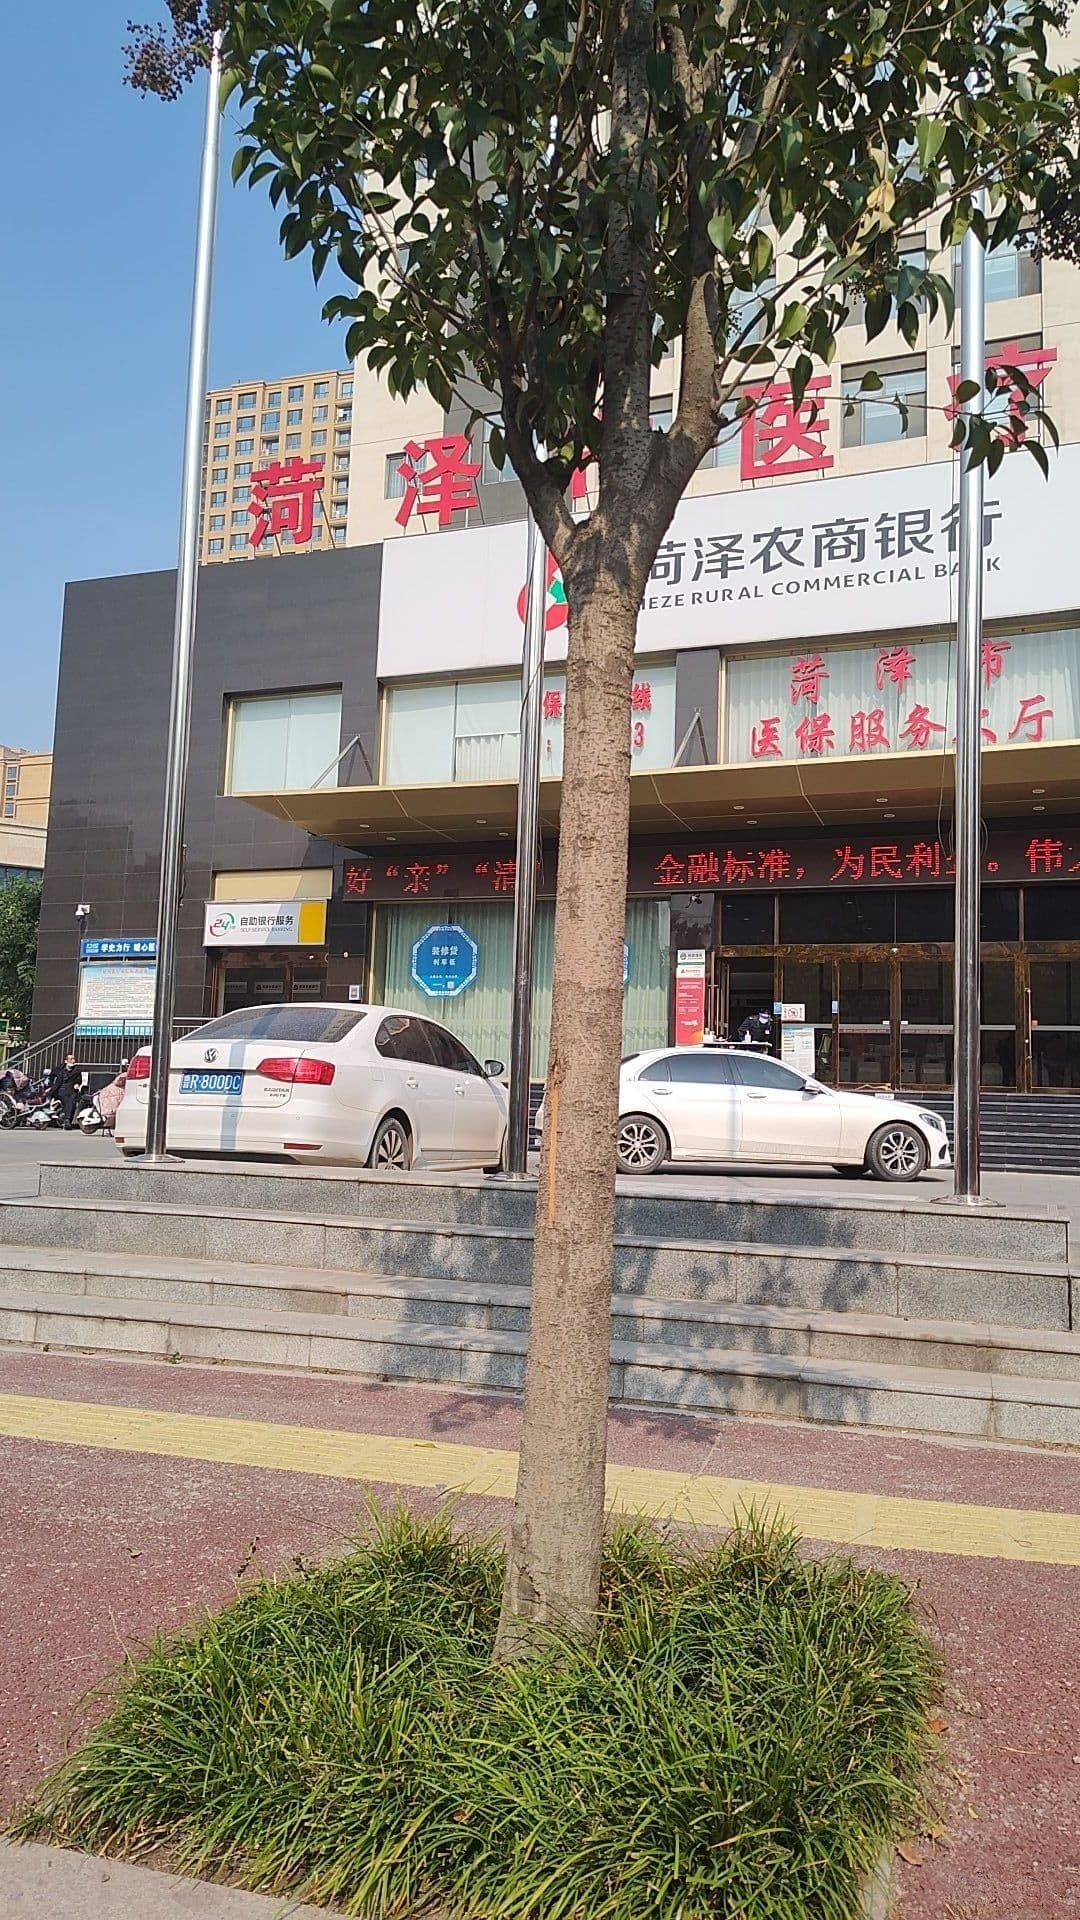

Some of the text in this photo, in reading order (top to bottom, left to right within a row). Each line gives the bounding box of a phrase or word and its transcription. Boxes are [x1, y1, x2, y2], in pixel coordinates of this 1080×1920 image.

[691, 585, 764, 605] RURAL
[771, 566, 926, 596] COMMERCIAL
[934, 556, 1001, 579] BAK
[240, 914, 295, 927] 自助银行服务
